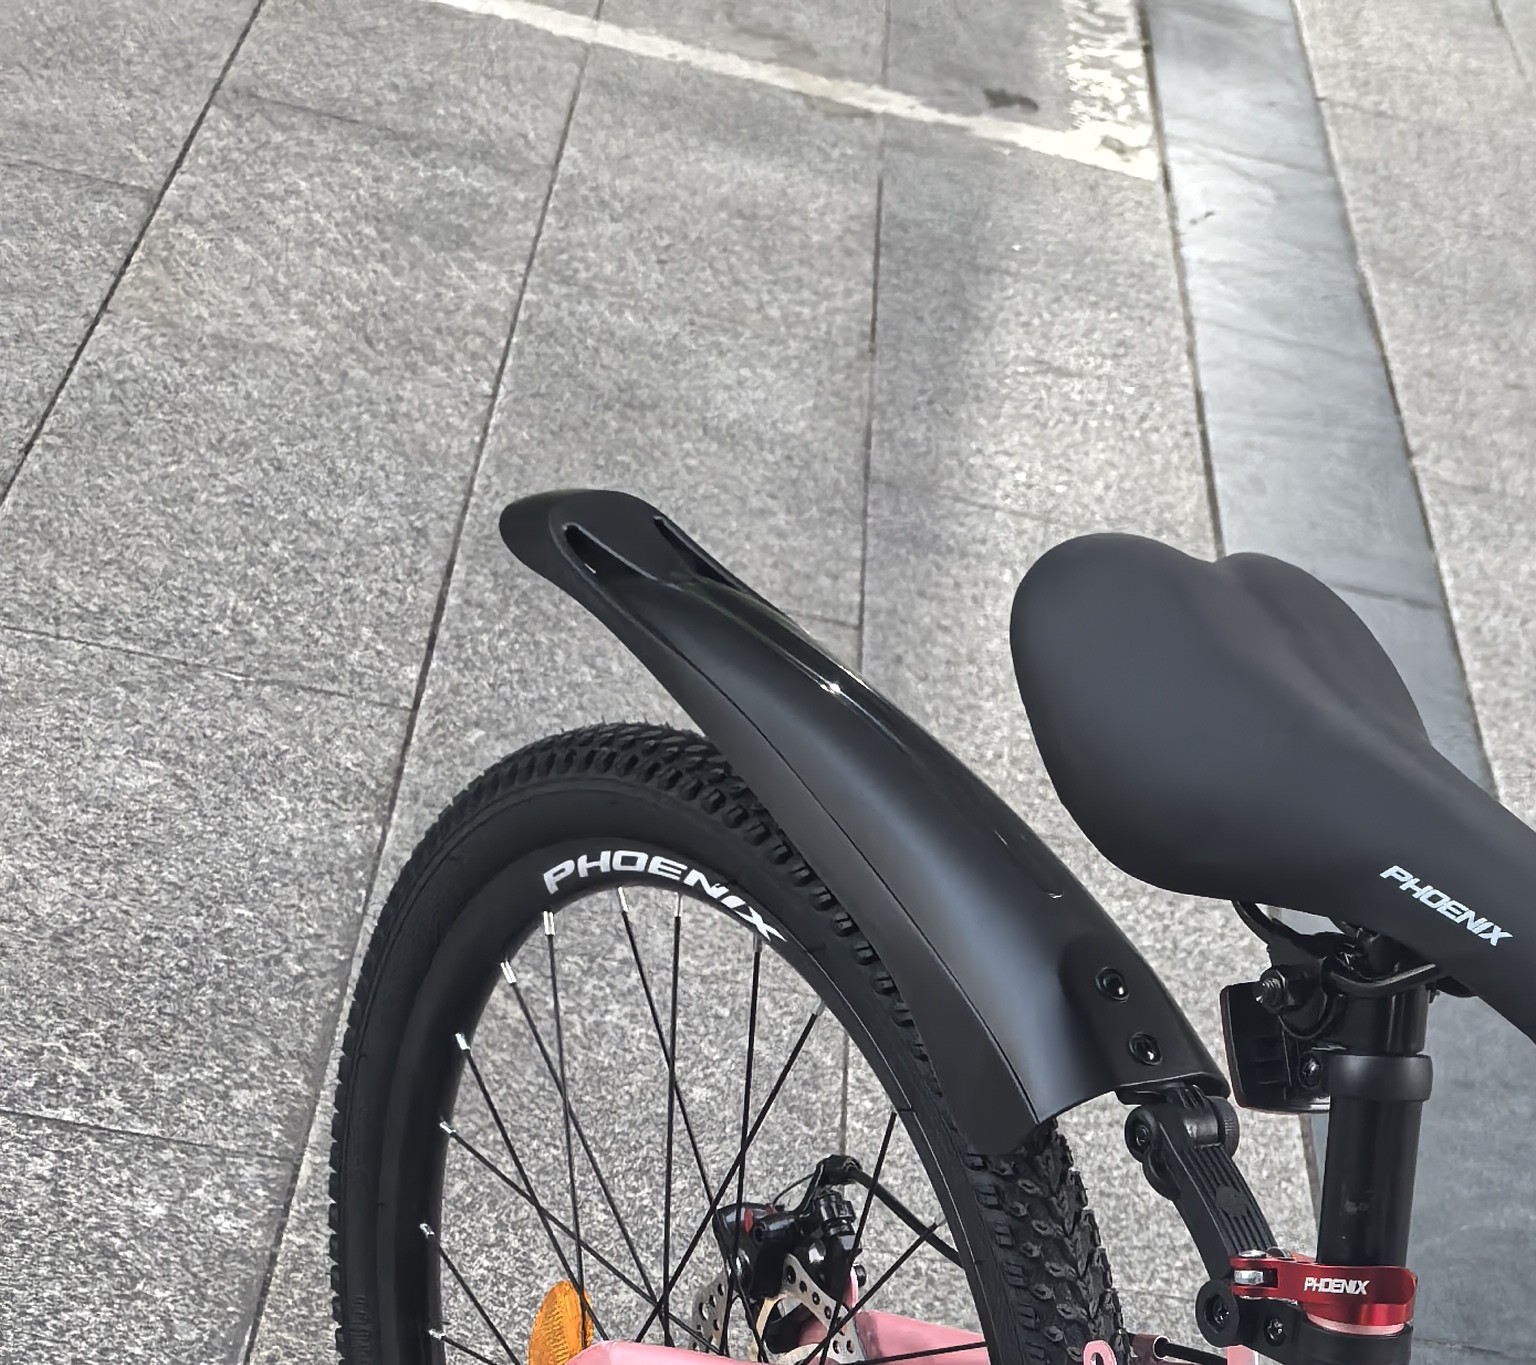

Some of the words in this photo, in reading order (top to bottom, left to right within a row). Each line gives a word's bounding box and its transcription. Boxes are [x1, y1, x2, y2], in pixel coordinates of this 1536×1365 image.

[543, 850, 787, 943] PHOENIX
[1380, 865, 1513, 947] PHOENIX
[1304, 1277, 1370, 1295] PHOENIX
